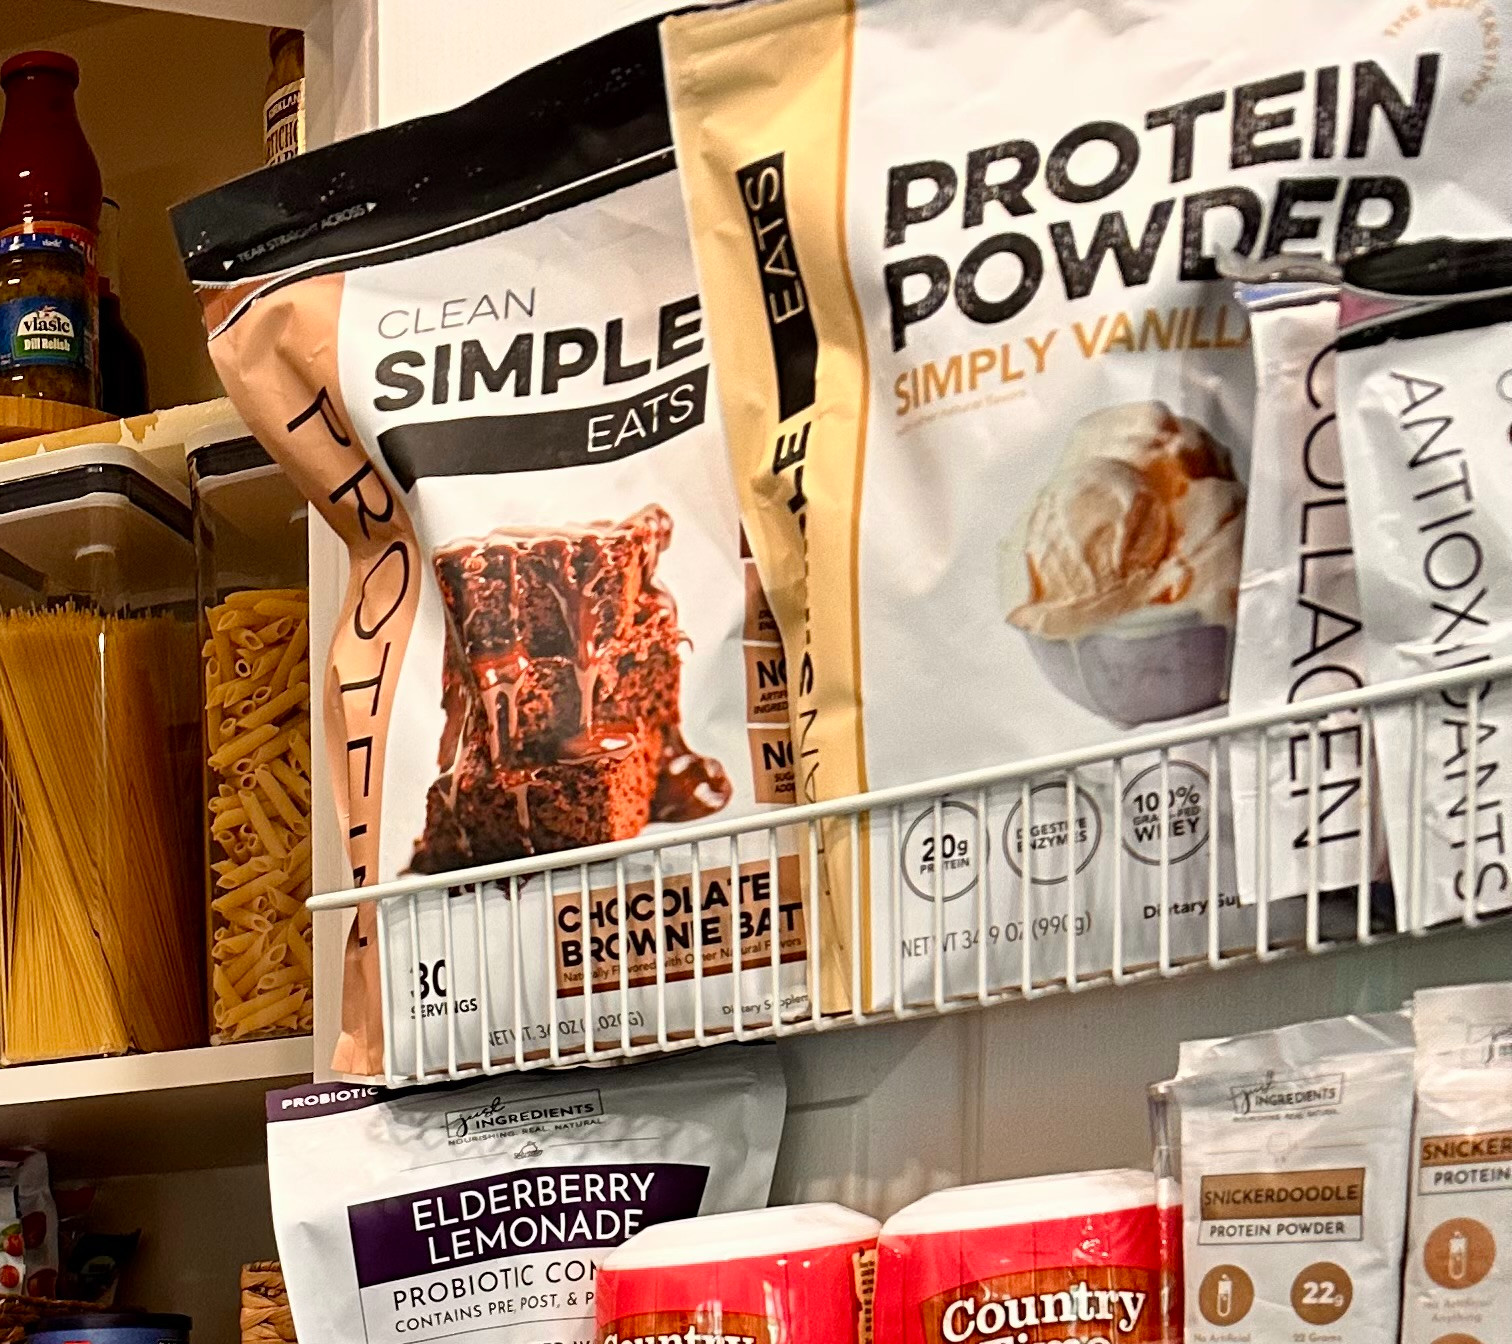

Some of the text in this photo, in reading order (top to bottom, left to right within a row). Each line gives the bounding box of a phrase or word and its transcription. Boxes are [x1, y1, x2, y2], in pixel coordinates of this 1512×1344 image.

[884, 52, 1440, 247] PROTEIN
[747, 160, 805, 325] EATS
[377, 287, 537, 340] CLEAN
[42, 337, 70, 351] Relish
[373, 295, 705, 413] SIMPLE
[896, 329, 1056, 417] SIMPLY
[587, 382, 695, 453] EATS
[281, 1085, 380, 1111] PROBIOTIC
[474, 1102, 595, 1130] INGREDIENTS
[1255, 1087, 1337, 1108] INGREDIENTS
[412, 1172, 656, 1232] ELDERBERRY
[1203, 1183, 1360, 1208] SNICKERDOODLE
[428, 1208, 644, 1265] LEMONADE
[1209, 1220, 1346, 1239] PROTEIN POWDER
[393, 1263, 535, 1311] PROBIOTIC
[1301, 1281, 1344, 1308] 22g
[395, 1303, 483, 1334] CONTAINS
[941, 1283, 1146, 1343] Country
